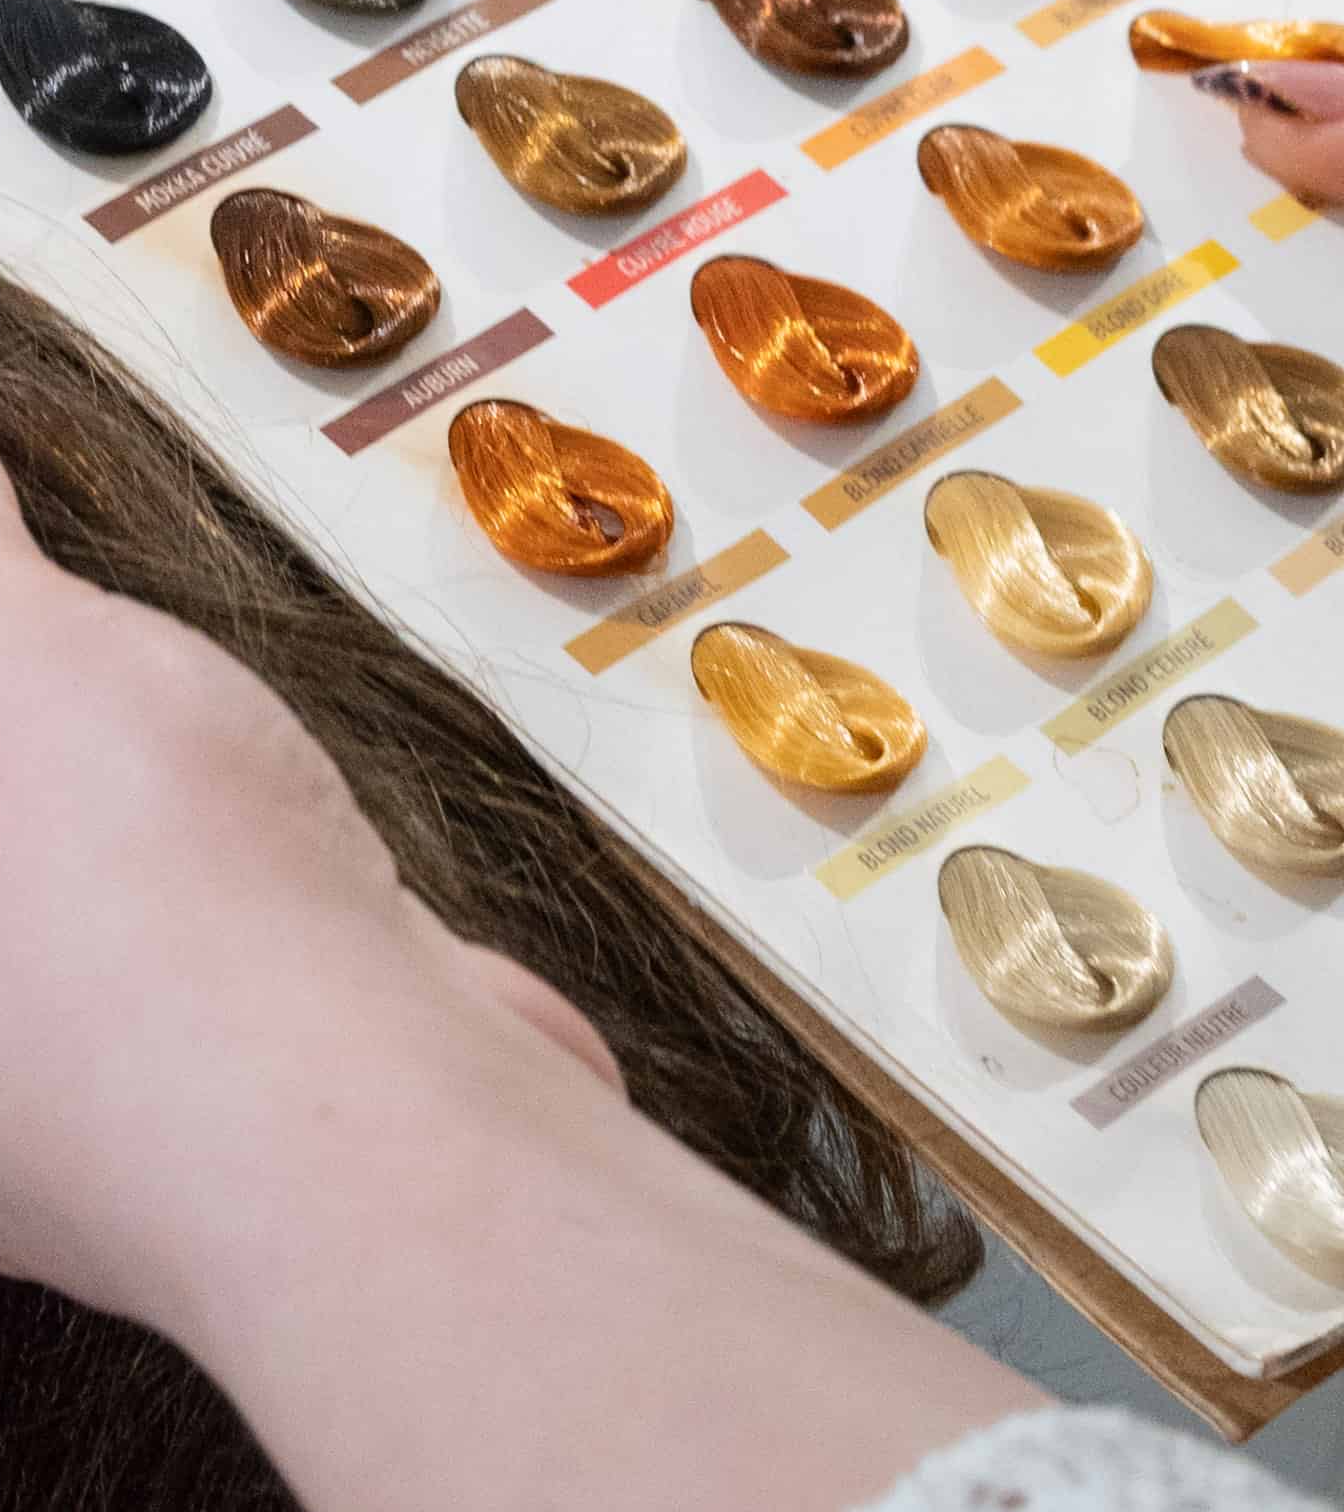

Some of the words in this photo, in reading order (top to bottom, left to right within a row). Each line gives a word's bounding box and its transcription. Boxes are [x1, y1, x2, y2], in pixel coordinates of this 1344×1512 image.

[133, 164, 208, 213] MOKKA
[198, 125, 274, 177] CUIVRÉ
[679, 194, 744, 241] ROUGE
[1086, 296, 1147, 340] BLOND
[400, 351, 480, 408] AUBURN
[841, 453, 903, 501] BLOND
[636, 573, 721, 628] CARAMEL
[1085, 672, 1151, 723] BLOND
[1145, 623, 1216, 681] CENDRÉ
[856, 823, 920, 872] BLOND
[911, 782, 992, 836] NATUREL
[1107, 1040, 1187, 1104] COULEUR
[1181, 998, 1249, 1052] NEUTRE
